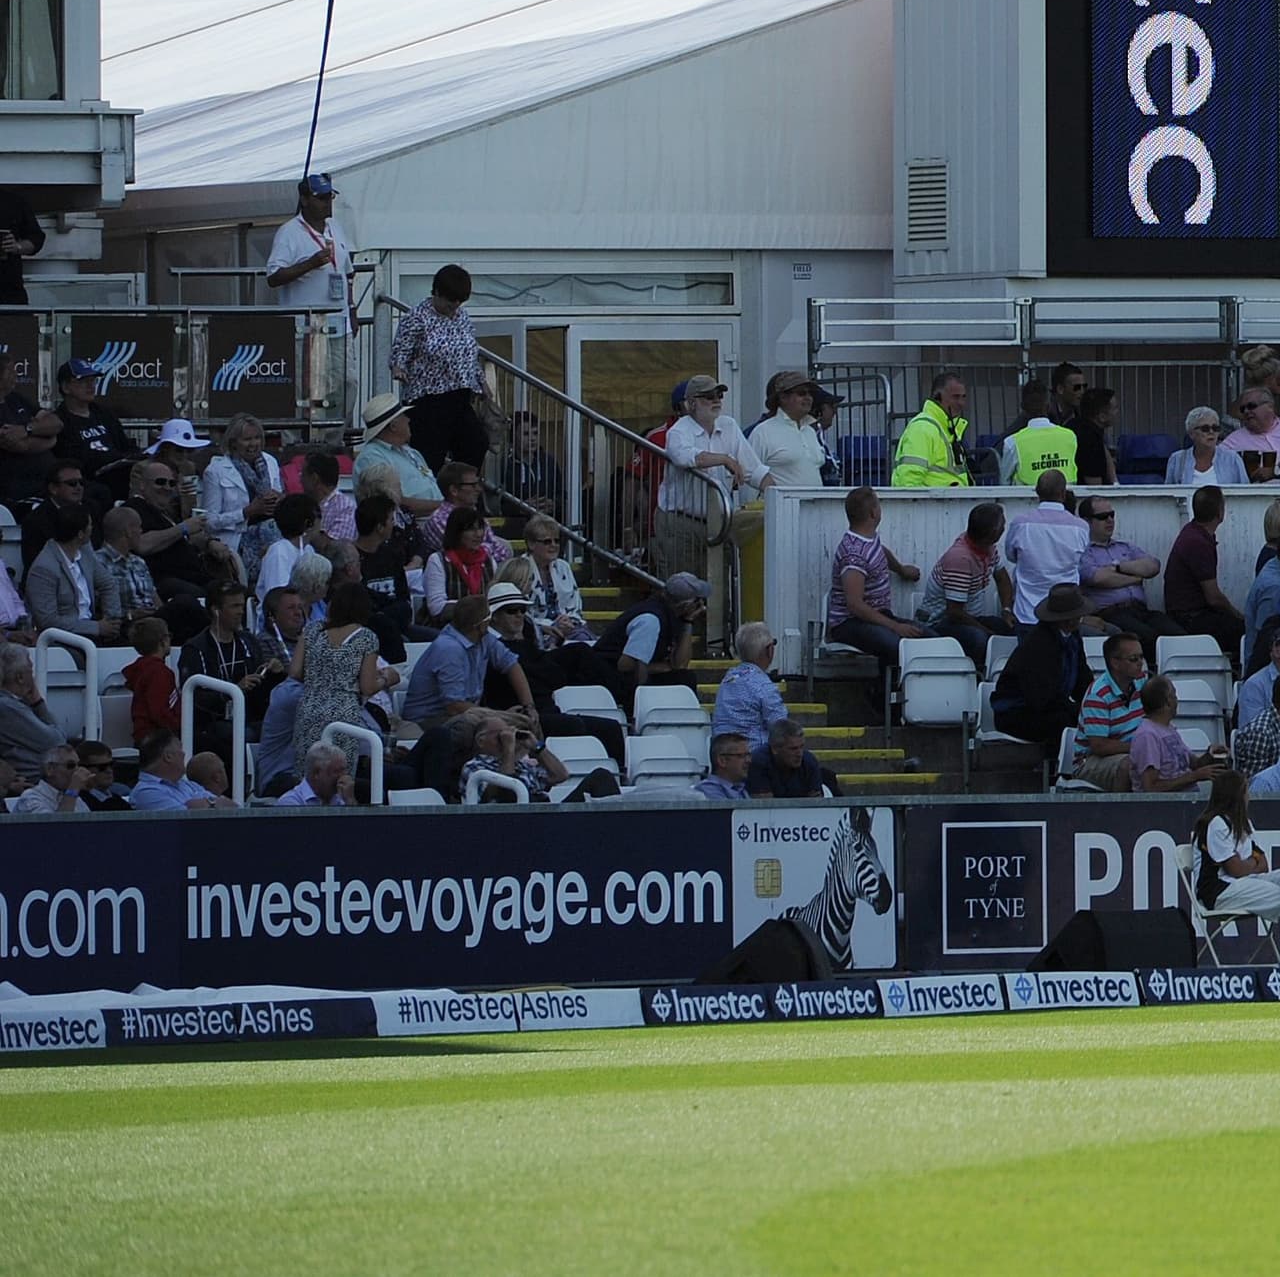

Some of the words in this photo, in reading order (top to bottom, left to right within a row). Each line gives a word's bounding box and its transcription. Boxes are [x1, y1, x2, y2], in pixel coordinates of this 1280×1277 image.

[1031, 459, 1069, 471] SECURITY
[753, 822, 830, 843] Investec
[964, 855, 1027, 879] PORT
[988, 880, 999, 894] of
[187, 865, 724, 949] investecvoyage.com
[964, 897, 1026, 919] TYNE
[793, 983, 878, 1016] Investec
[905, 977, 996, 1011] Investec
[1037, 972, 1132, 1006] Investec
[1169, 967, 1255, 1001] Investec
[672, 989, 766, 1024] Investec
